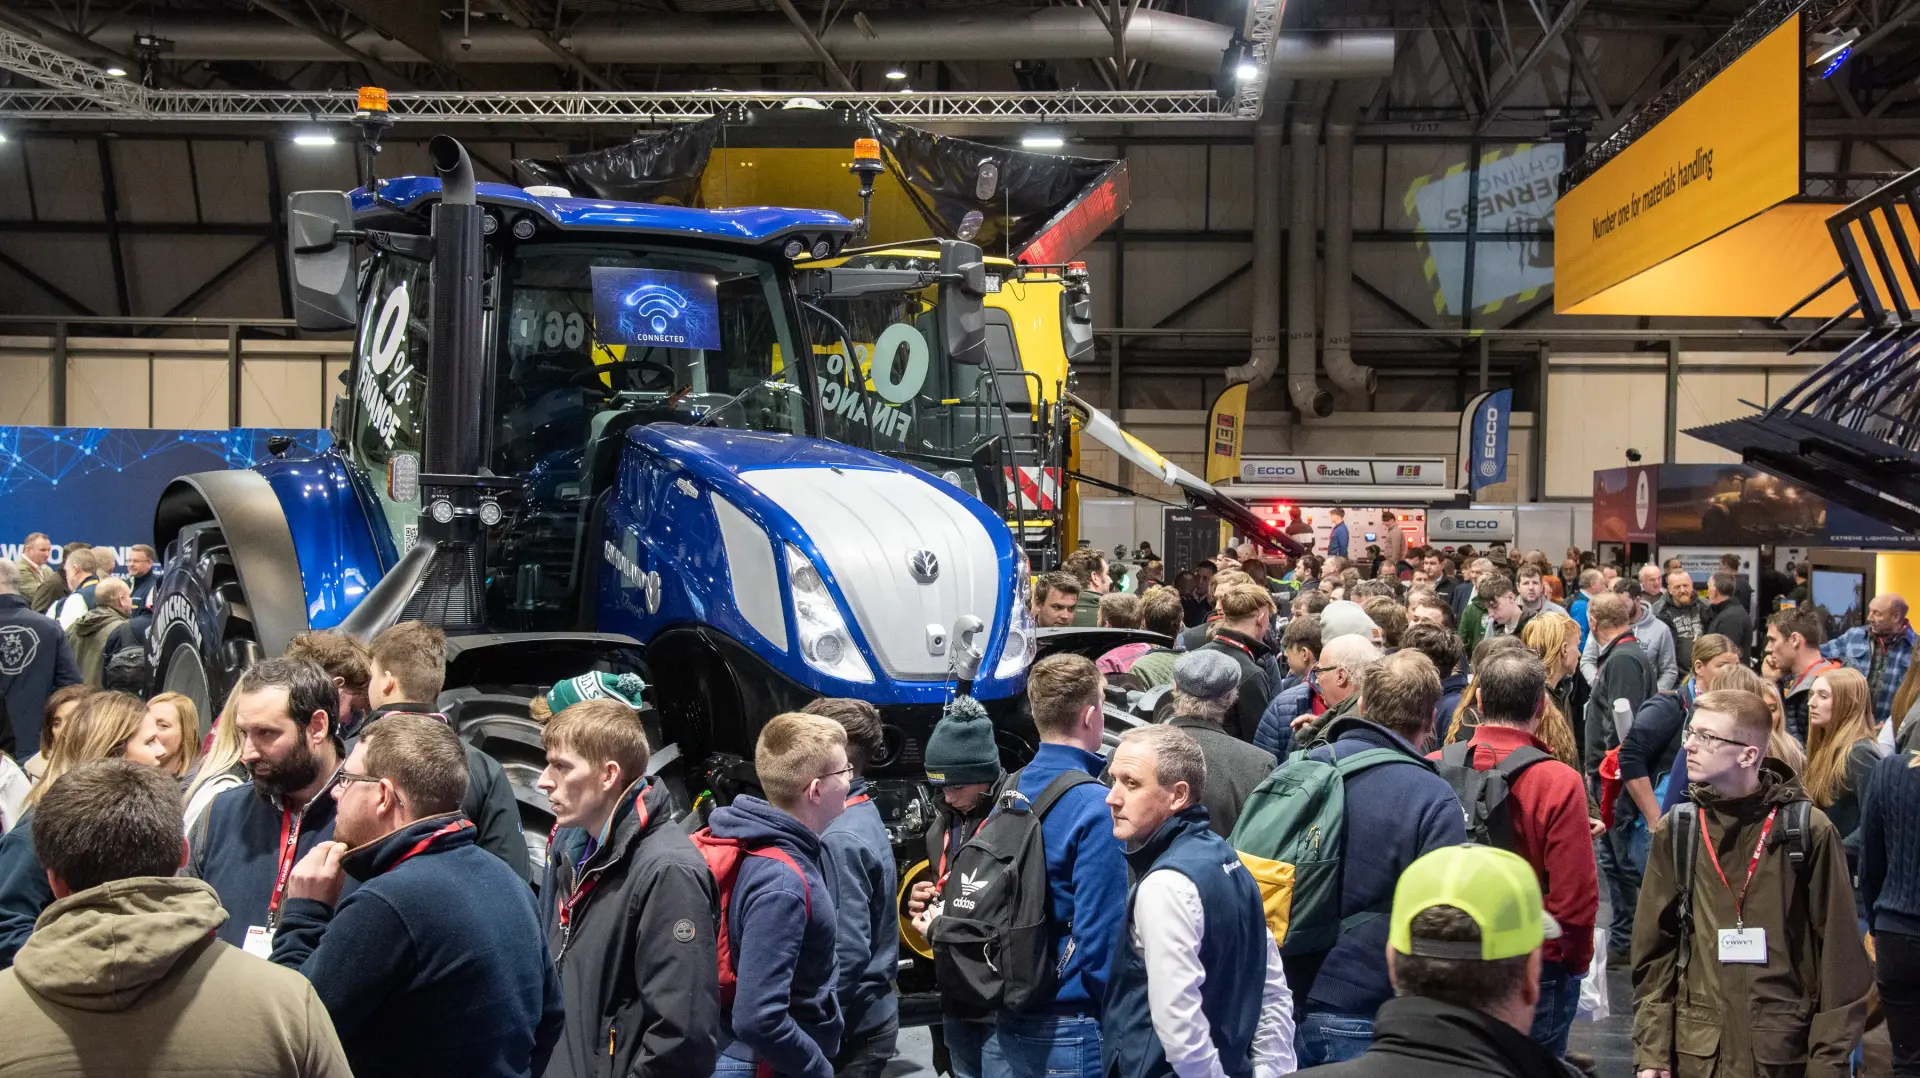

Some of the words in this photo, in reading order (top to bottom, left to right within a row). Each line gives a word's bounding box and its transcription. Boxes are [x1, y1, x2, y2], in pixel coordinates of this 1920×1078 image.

[1593, 209, 1616, 242] Number
[1618, 203, 1629, 226] one
[1631, 192, 1641, 219] for
[1642, 167, 1675, 212] materials
[1678, 146, 1713, 190] handling
[637, 333, 684, 343] CONNECTED
[358, 361, 402, 450] FINANCE
[1484, 408, 1498, 458] ECCO
[1257, 467, 1296, 475] ECCO
[1456, 520, 1498, 529] ECCO
[157, 594, 203, 650] MICHELIN
[953, 897, 976, 909] adidas
